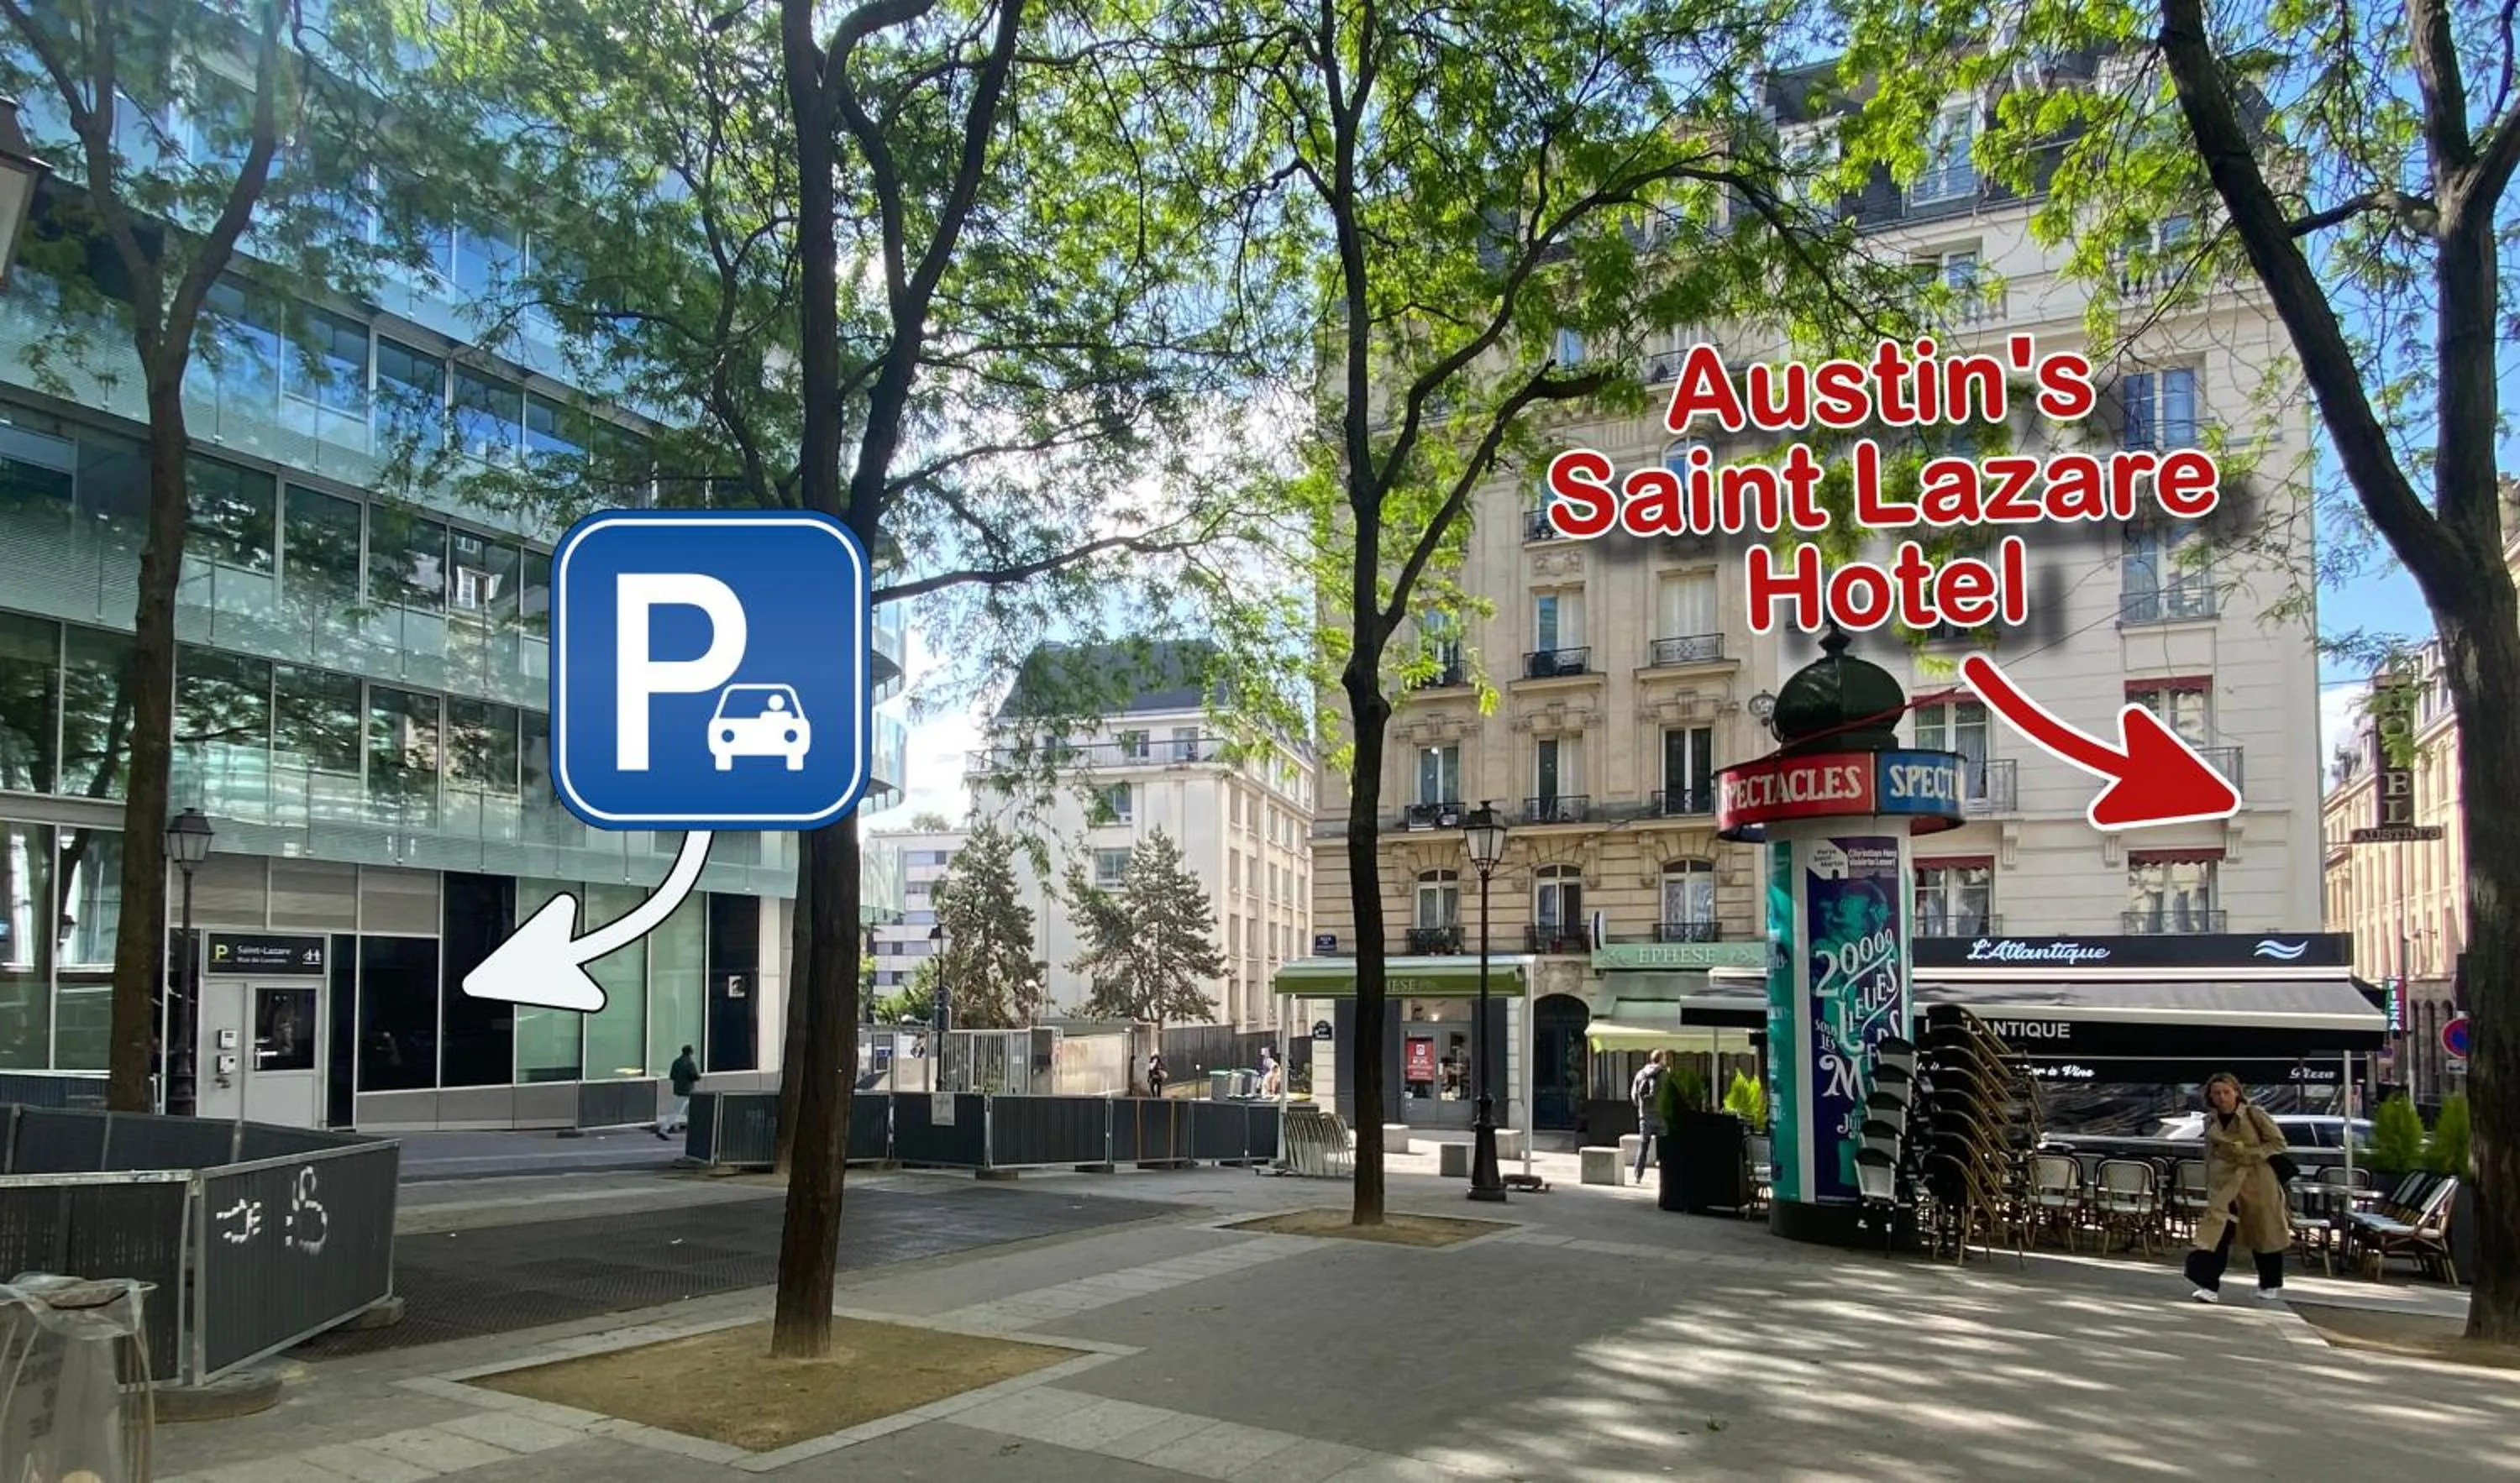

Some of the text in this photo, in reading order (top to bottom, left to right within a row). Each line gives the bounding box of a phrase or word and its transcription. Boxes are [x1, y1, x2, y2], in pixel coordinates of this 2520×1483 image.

[1724, 765, 1861, 812] PECTACLES
[1889, 764, 1963, 800] SPECT
[215, 945, 228, 960] P
[1638, 947, 1716, 963] EPHESE
[1966, 938, 2111, 965] L'Atlantique
